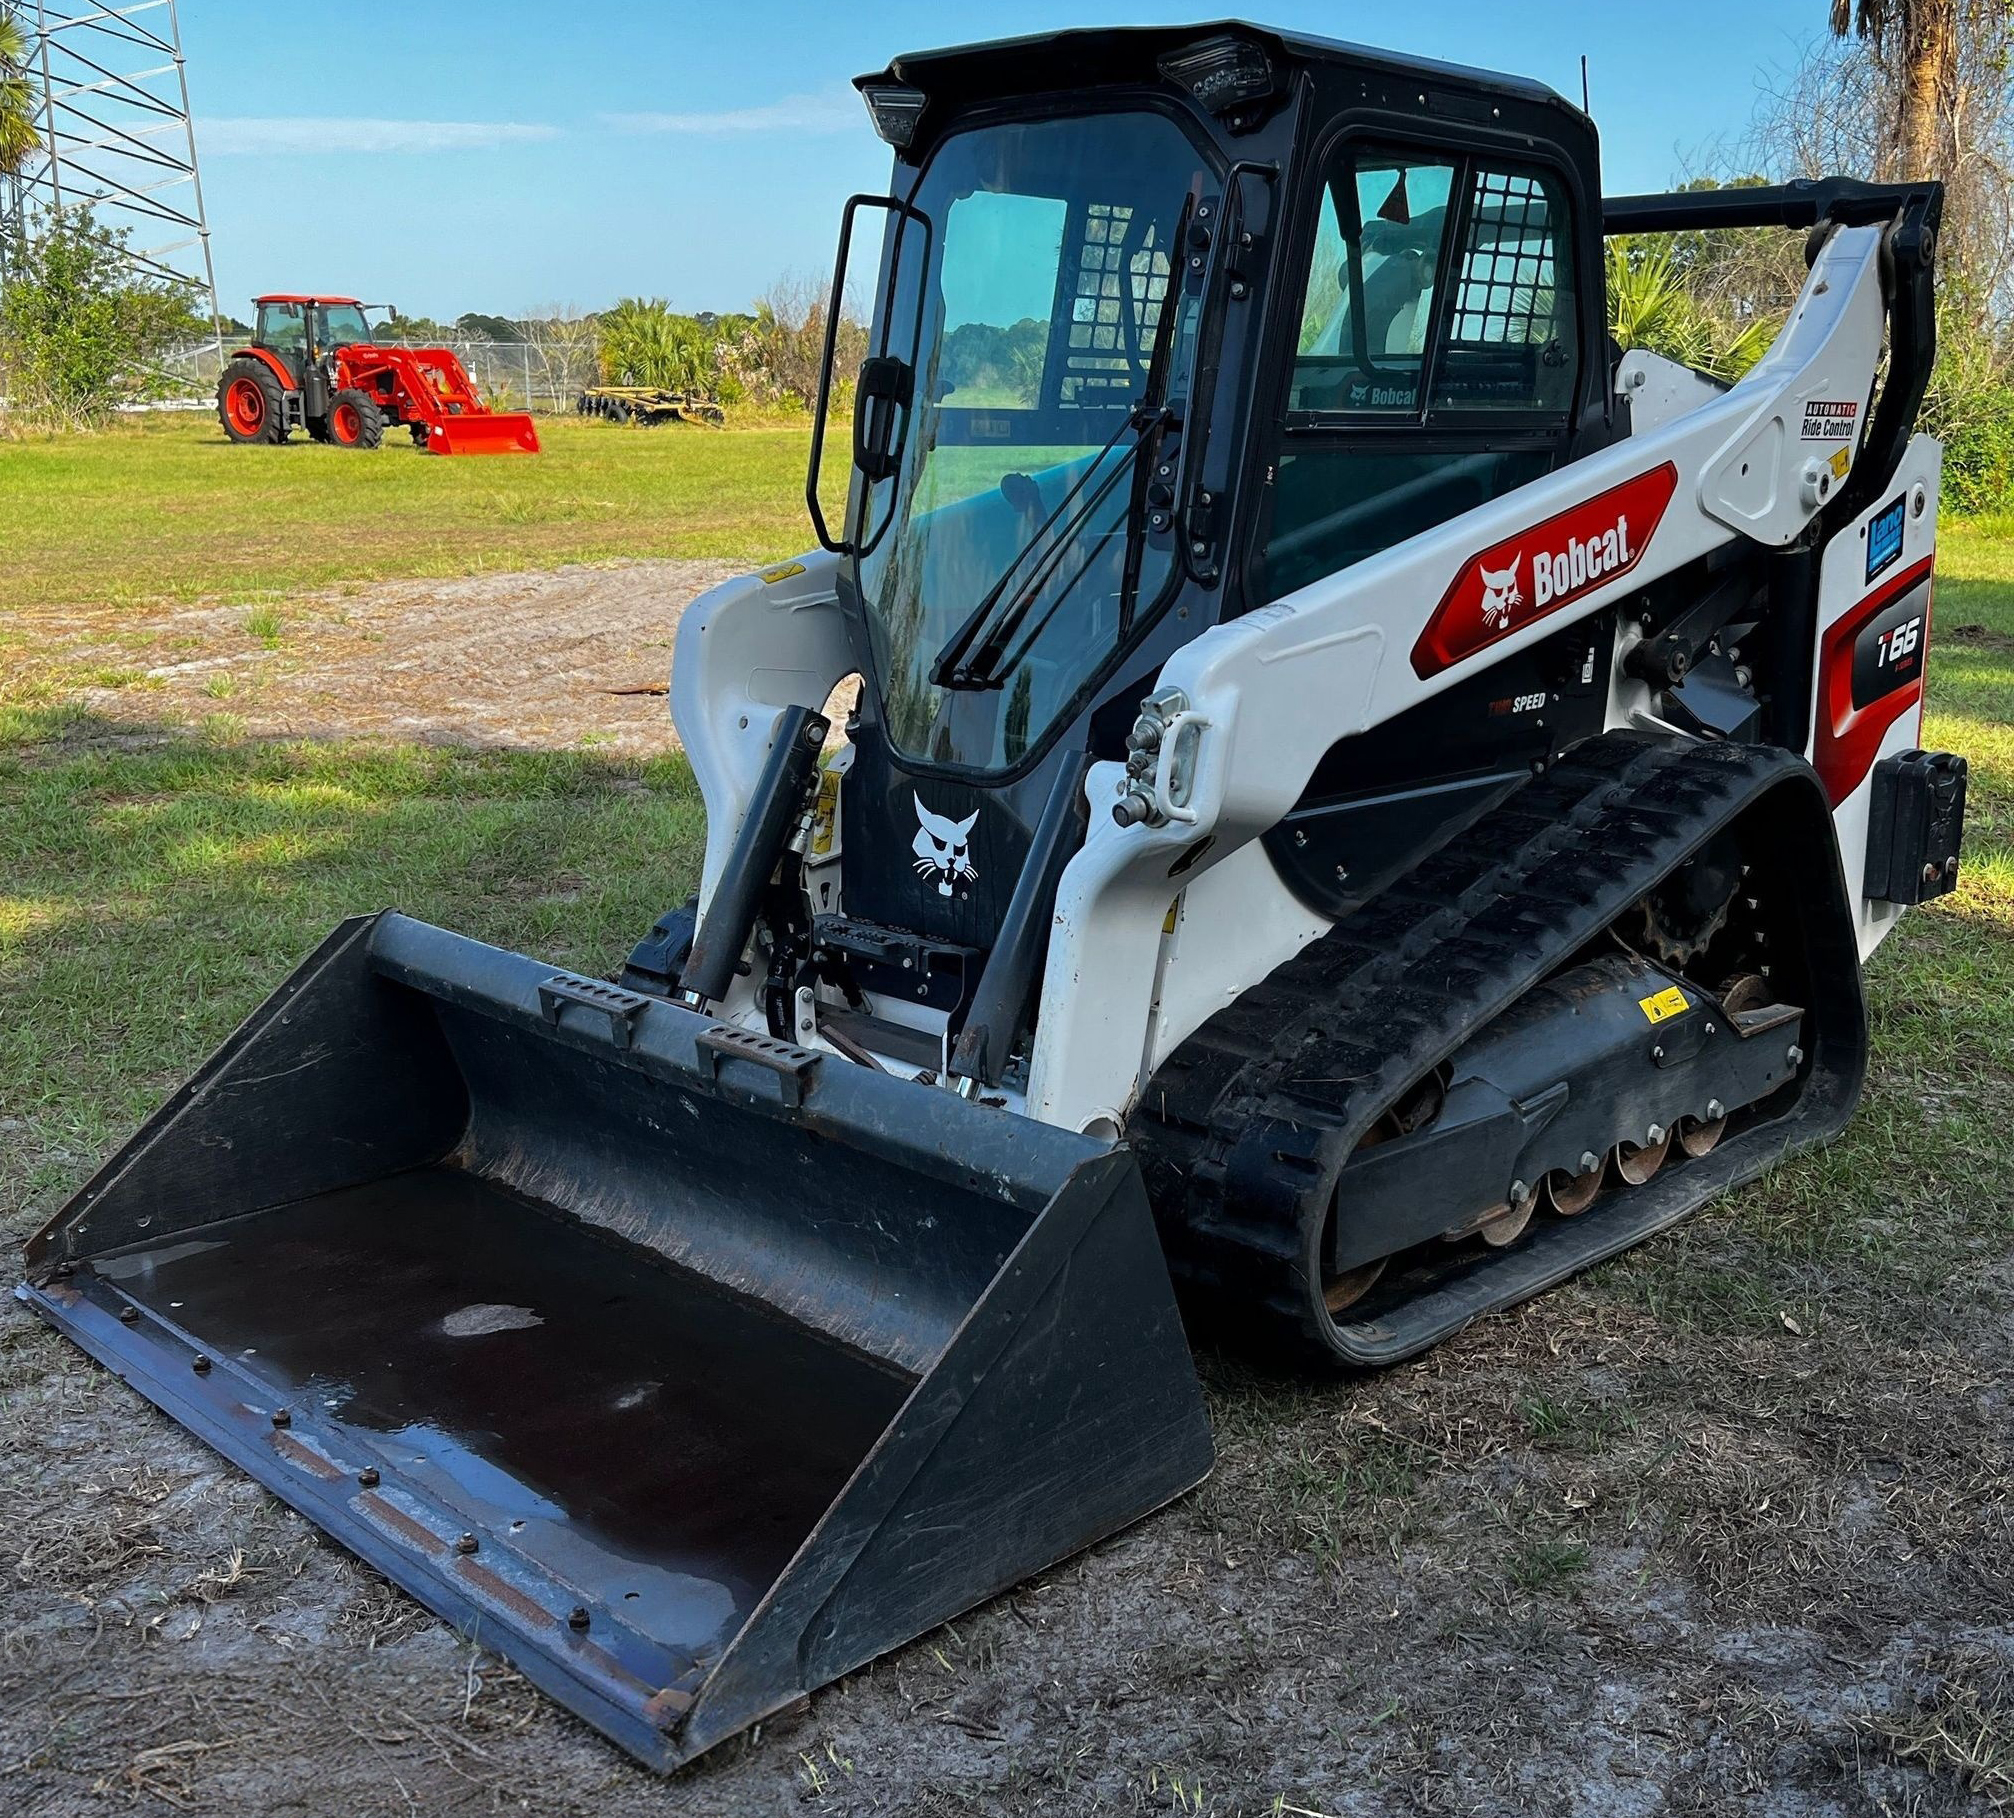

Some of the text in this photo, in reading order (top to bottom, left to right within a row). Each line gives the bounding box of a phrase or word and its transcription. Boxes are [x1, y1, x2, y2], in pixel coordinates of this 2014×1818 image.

[1806, 403, 1856, 416] AUTOMATIC
[1802, 418, 1855, 436] Ride Control
[1533, 514, 1629, 607] Bobcat
[1512, 693, 1546, 713] SPEED
